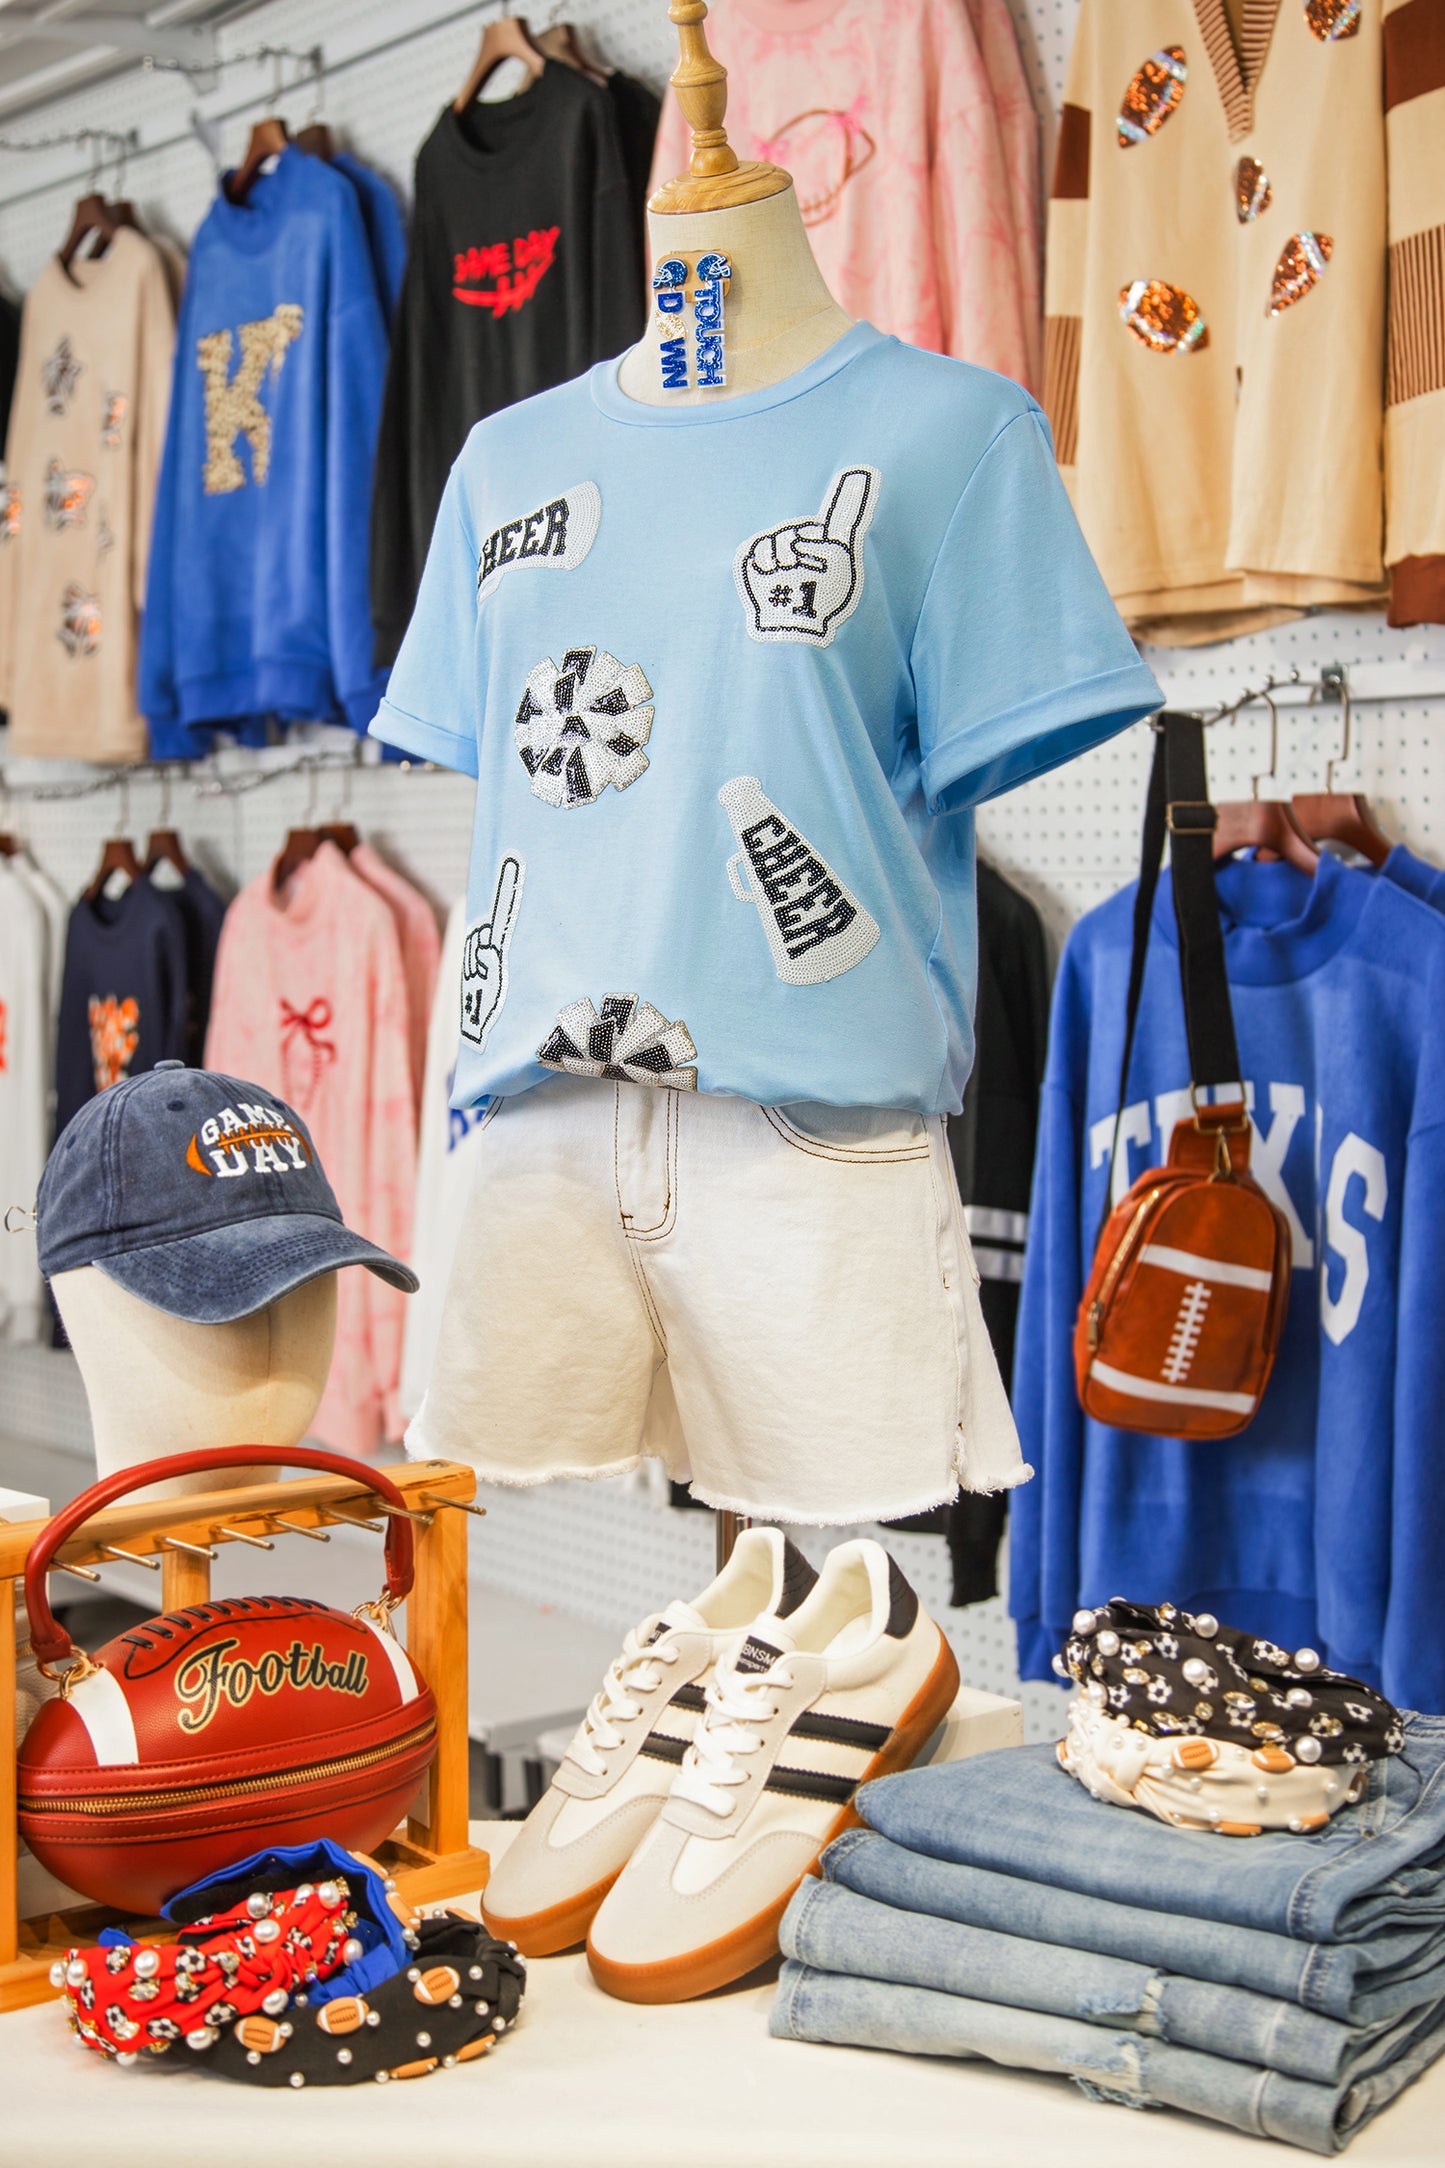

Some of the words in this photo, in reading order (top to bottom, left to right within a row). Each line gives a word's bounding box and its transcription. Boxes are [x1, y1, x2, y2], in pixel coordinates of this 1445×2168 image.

[693, 279, 725, 388] TOUCH
[477, 498, 570, 590] HEER
[768, 580, 818, 619] #1
[741, 814, 858, 960] CHEER
[464, 988, 483, 1026] #1
[209, 1136, 307, 1178] DAY
[1090, 1080, 1388, 1347] TXS
[174, 1637, 370, 1735] Football
